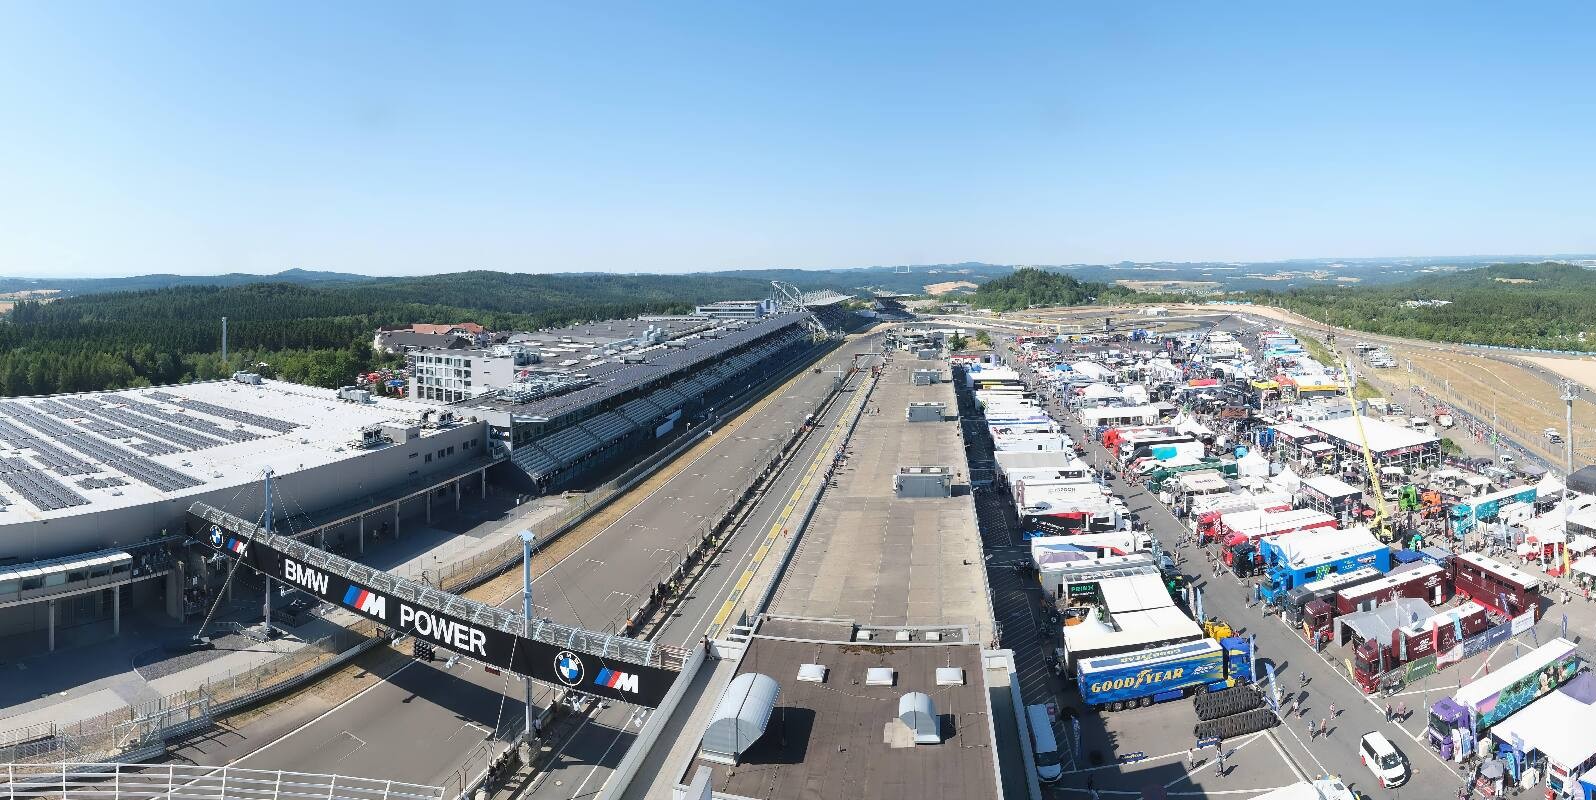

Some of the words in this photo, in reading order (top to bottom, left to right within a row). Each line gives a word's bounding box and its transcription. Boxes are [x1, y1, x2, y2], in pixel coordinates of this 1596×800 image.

[285, 559, 328, 595] BMW
[400, 603, 487, 657] POWER
[1091, 667, 1184, 694] GOODYEAR
